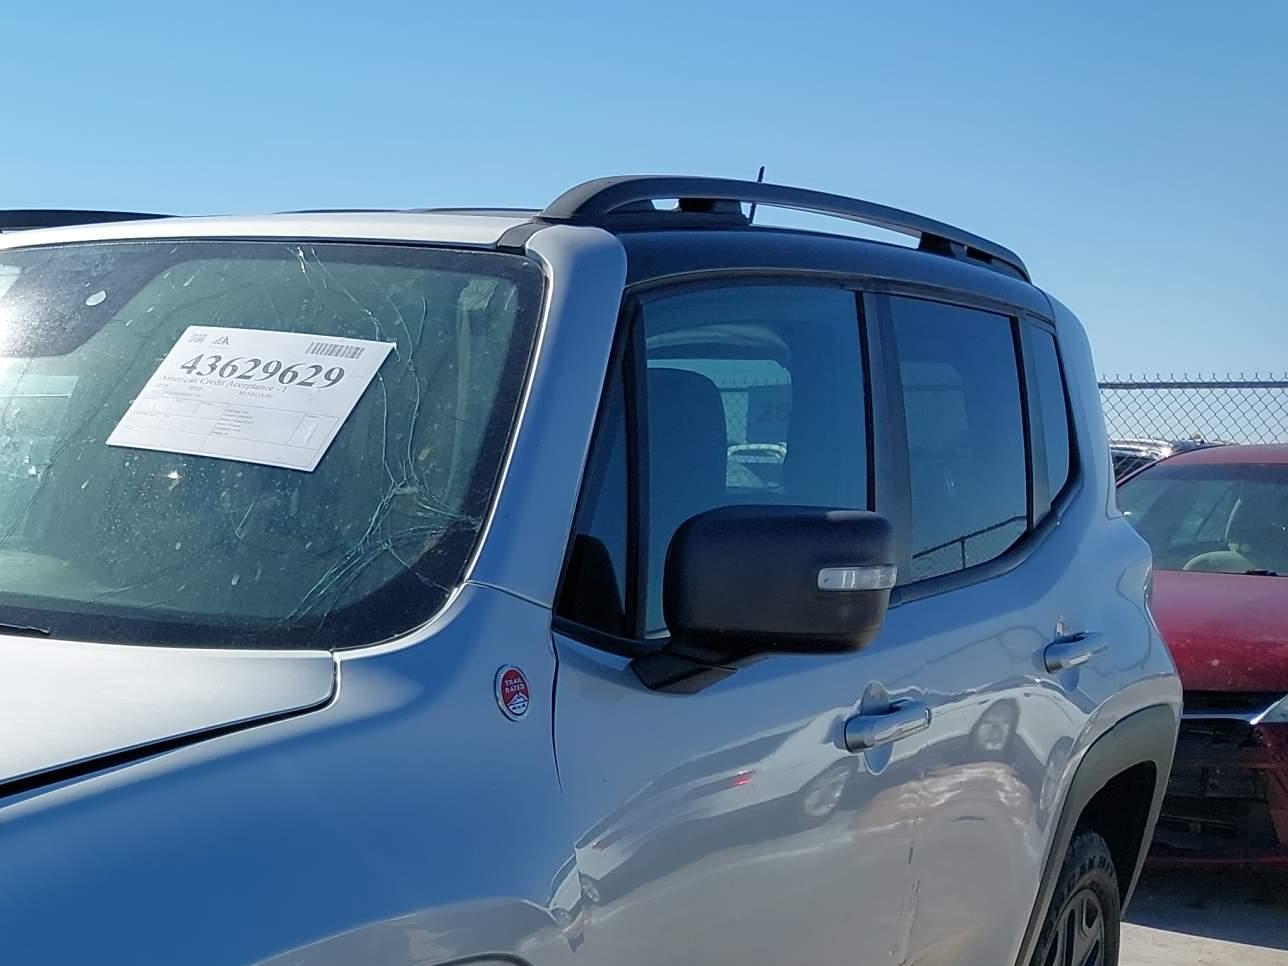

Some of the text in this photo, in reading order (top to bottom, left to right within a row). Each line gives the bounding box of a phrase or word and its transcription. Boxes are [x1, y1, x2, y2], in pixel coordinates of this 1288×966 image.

[180, 353, 346, 389] 43629629
[160, 375, 198, 384] American
[199, 376, 225, 387] Credit
[225, 381, 275, 392] Acceptance
[504, 678, 523, 686] TRAIL
[505, 684, 524, 694] RATED
